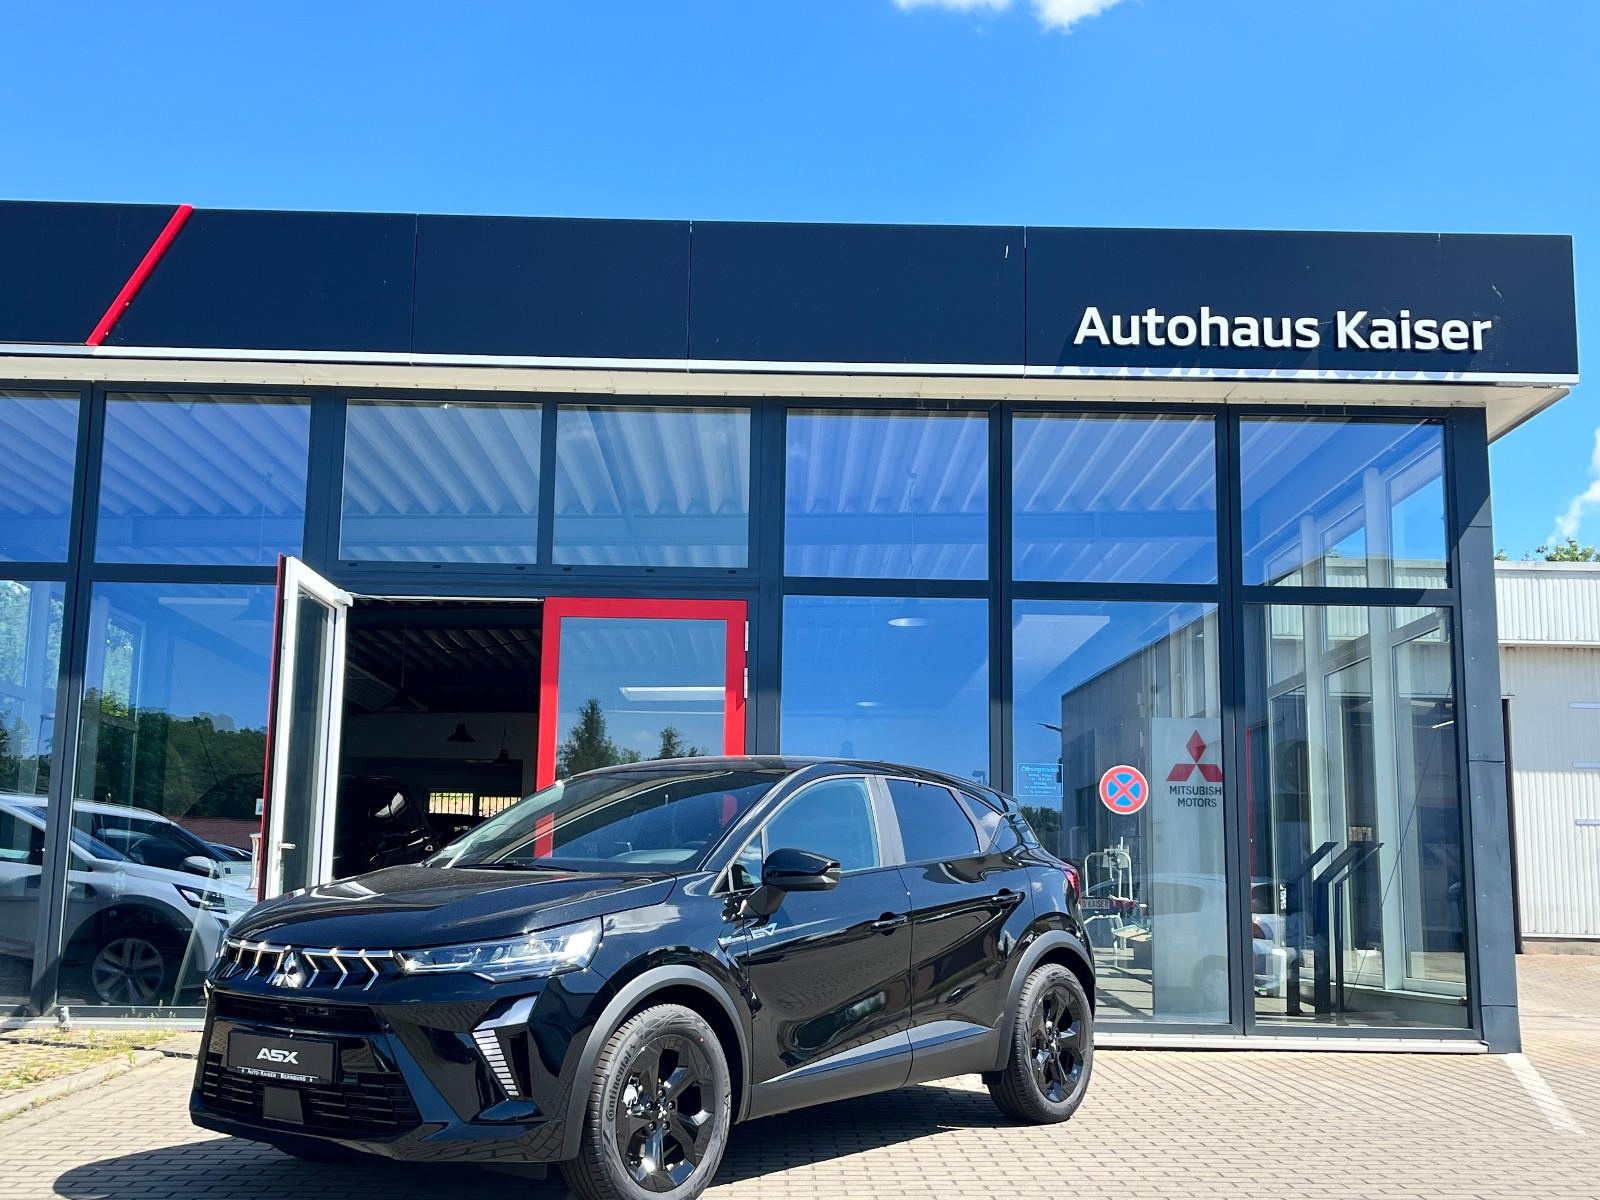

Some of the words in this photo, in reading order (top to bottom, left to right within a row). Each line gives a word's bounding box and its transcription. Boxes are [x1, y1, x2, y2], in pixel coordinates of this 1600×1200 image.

[1073, 306, 1320, 349] Autohaus
[1336, 310, 1492, 352] Kaiser
[1169, 785, 1222, 796] MITSUBISH
[1177, 797, 1217, 808] MOTORS
[256, 1047, 299, 1065] ASX
